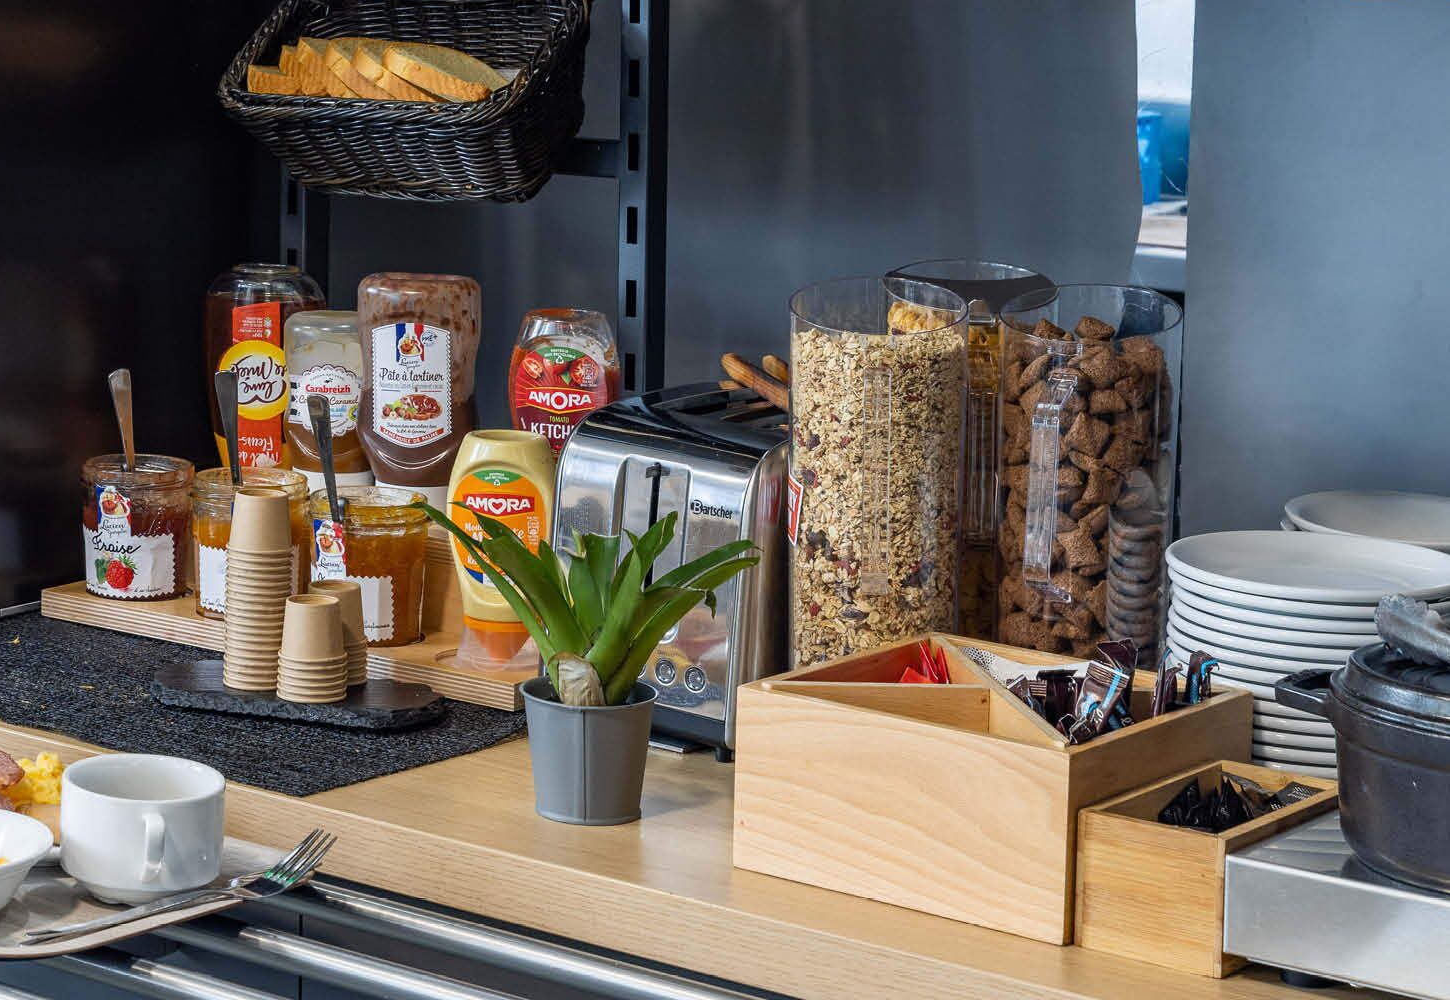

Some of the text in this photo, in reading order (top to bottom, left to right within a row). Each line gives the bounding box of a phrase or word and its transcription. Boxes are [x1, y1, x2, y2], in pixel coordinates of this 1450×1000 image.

[379, 367, 400, 382] Pâte
[409, 369, 444, 382] tartiner
[305, 384, 351, 393] Carabreizh
[528, 391, 592, 410] AMORA
[465, 495, 531, 515] AMORA
[690, 499, 733, 520] Bartscher
[91, 532, 142, 555] Fraise
